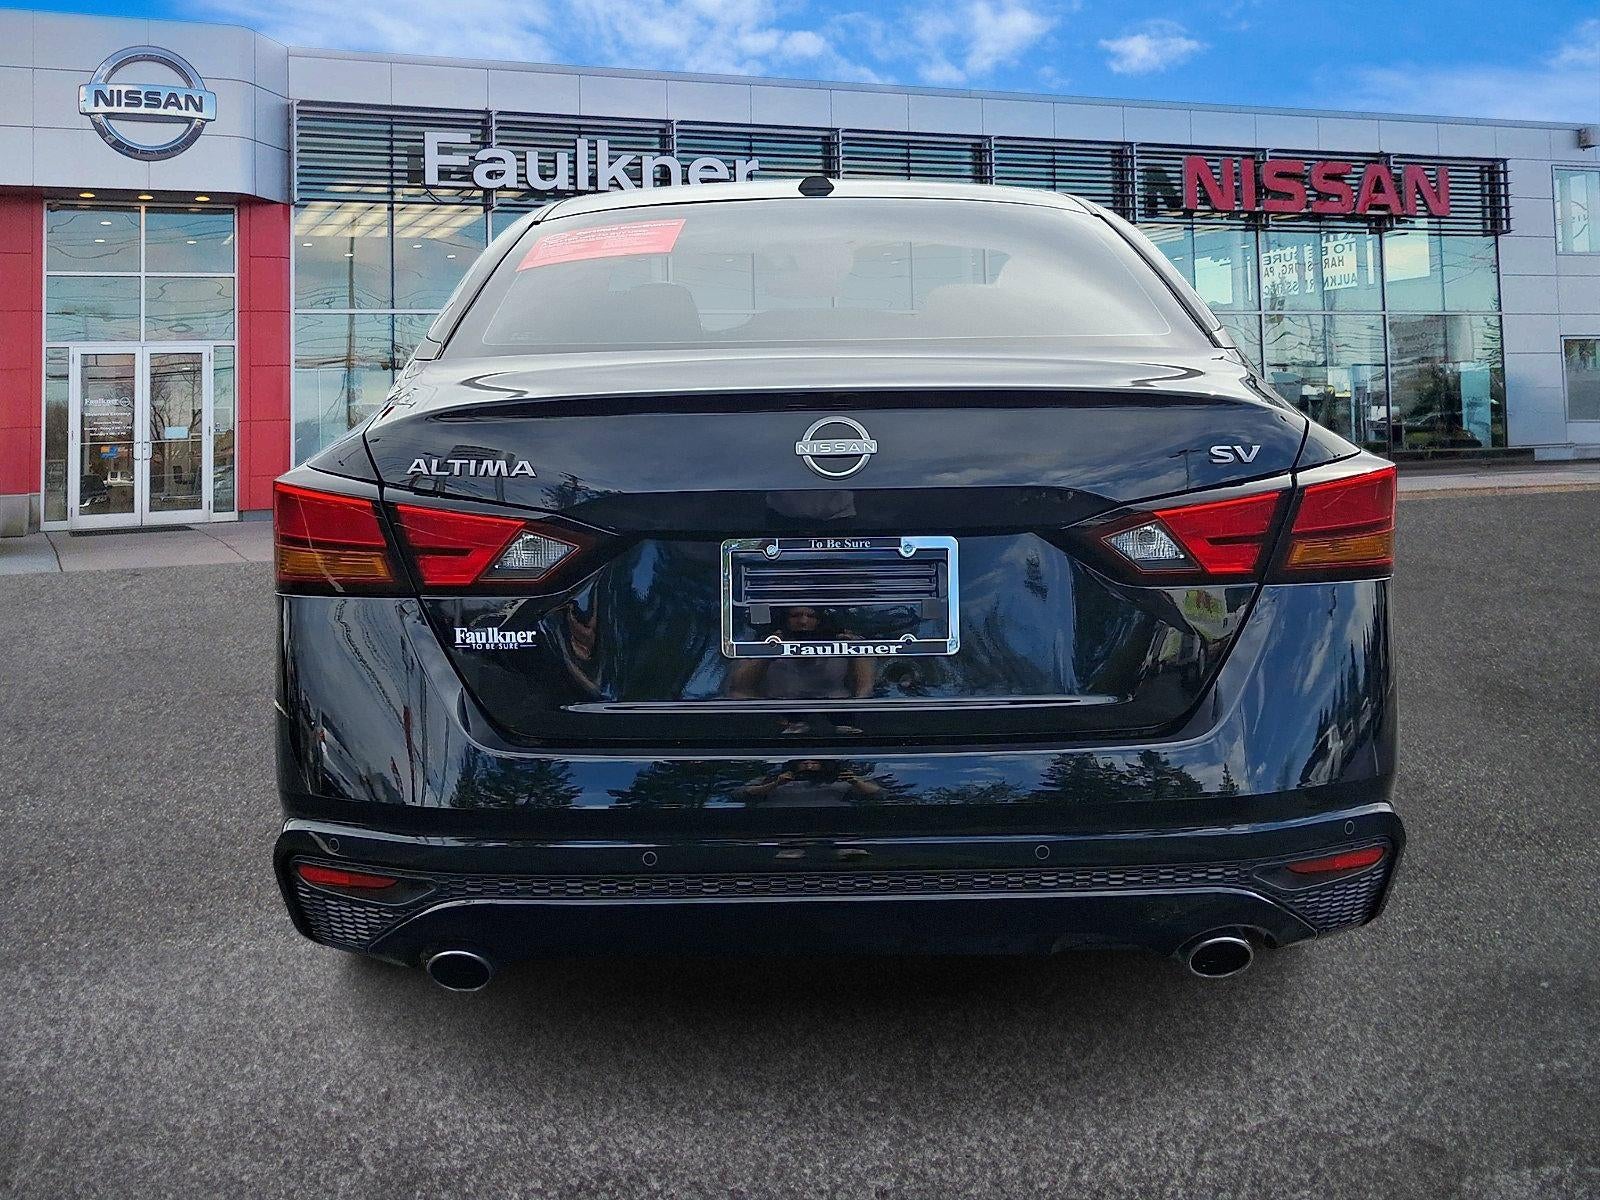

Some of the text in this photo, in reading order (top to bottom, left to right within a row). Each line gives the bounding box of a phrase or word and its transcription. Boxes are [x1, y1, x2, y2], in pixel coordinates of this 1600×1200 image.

[94, 90, 203, 113] NISSAN
[423, 131, 760, 192] Faulkner
[1182, 155, 1451, 217] NISSAN
[798, 442, 875, 453] NISSAN
[1210, 445, 1261, 463] SV
[402, 458, 537, 477] ALTIMA
[808, 538, 871, 548] To Be Sure
[454, 627, 537, 643] Faulkner
[780, 642, 903, 656] Faulkner
